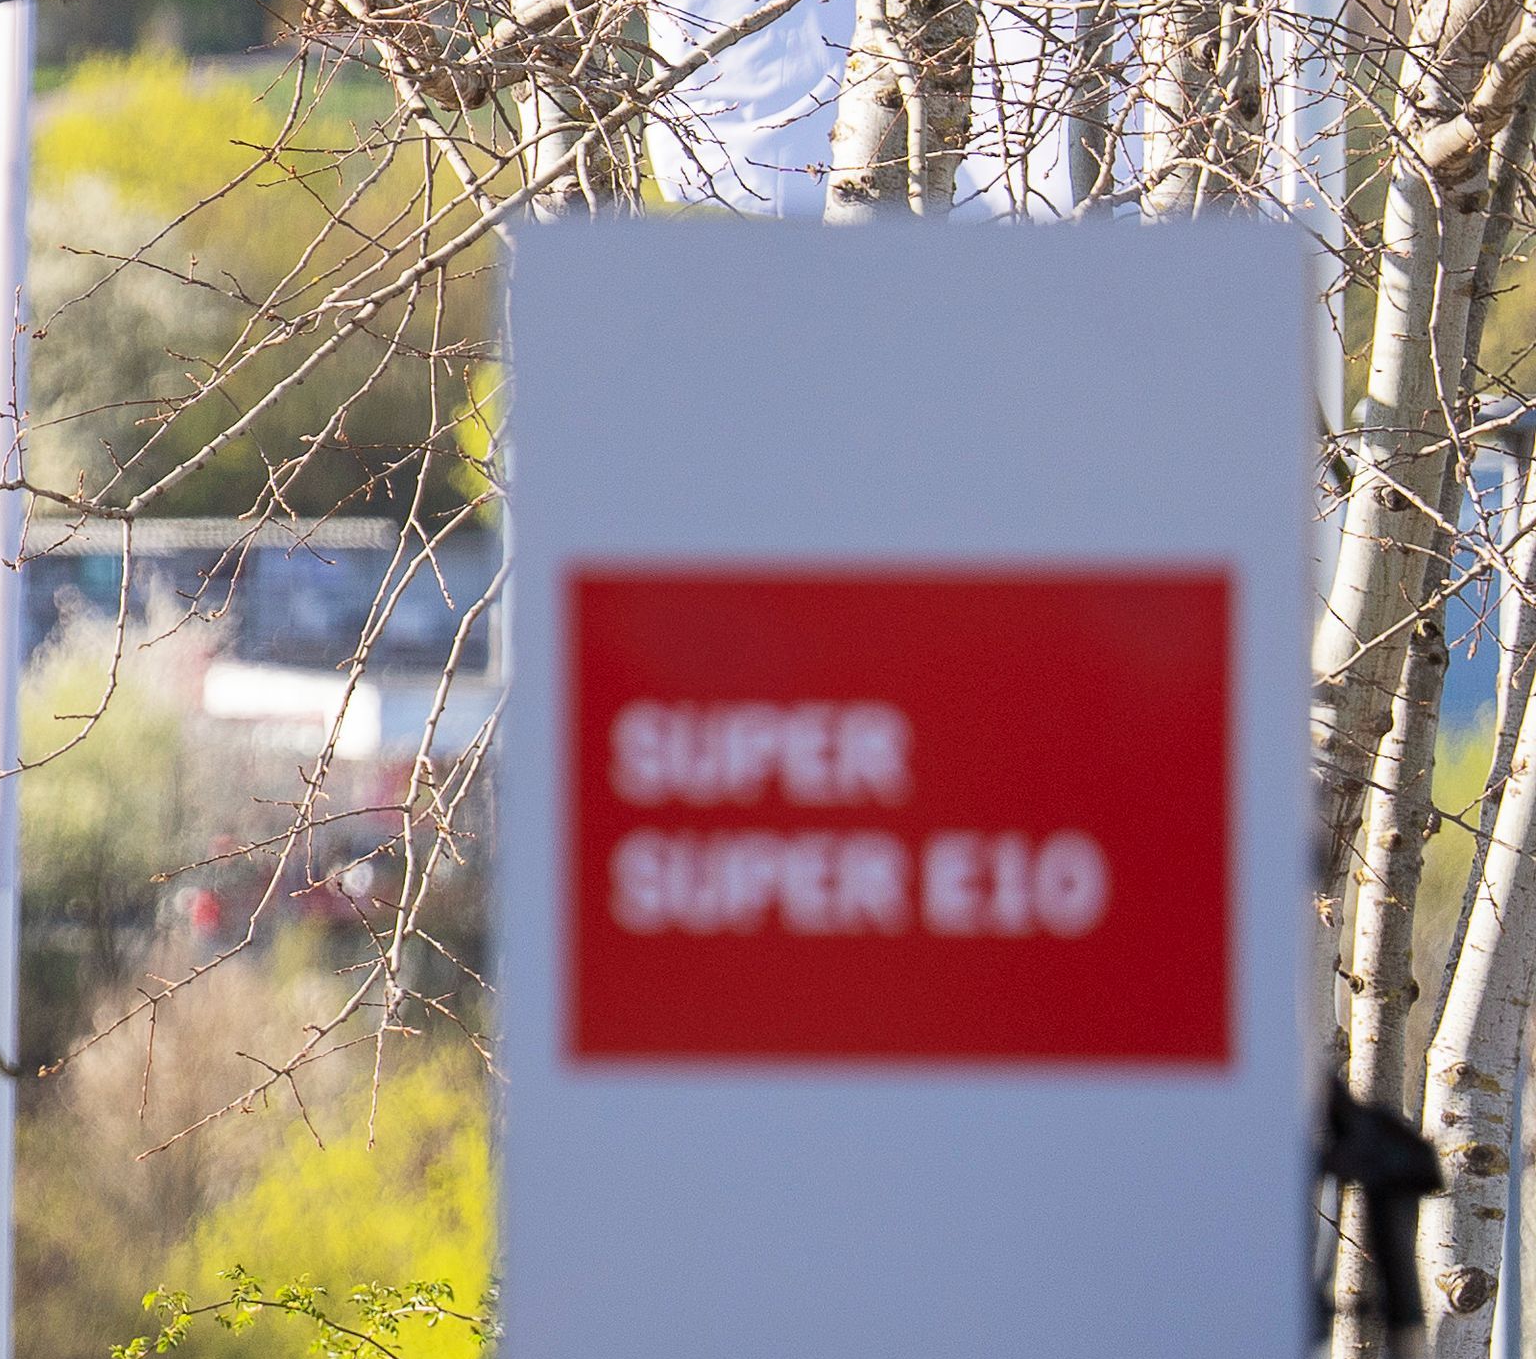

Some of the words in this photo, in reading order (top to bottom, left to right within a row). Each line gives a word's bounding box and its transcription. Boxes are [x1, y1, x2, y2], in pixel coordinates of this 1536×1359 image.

[612, 701, 912, 805] SUPER
[612, 829, 912, 933] SUPER
[925, 831, 1108, 937] E10
